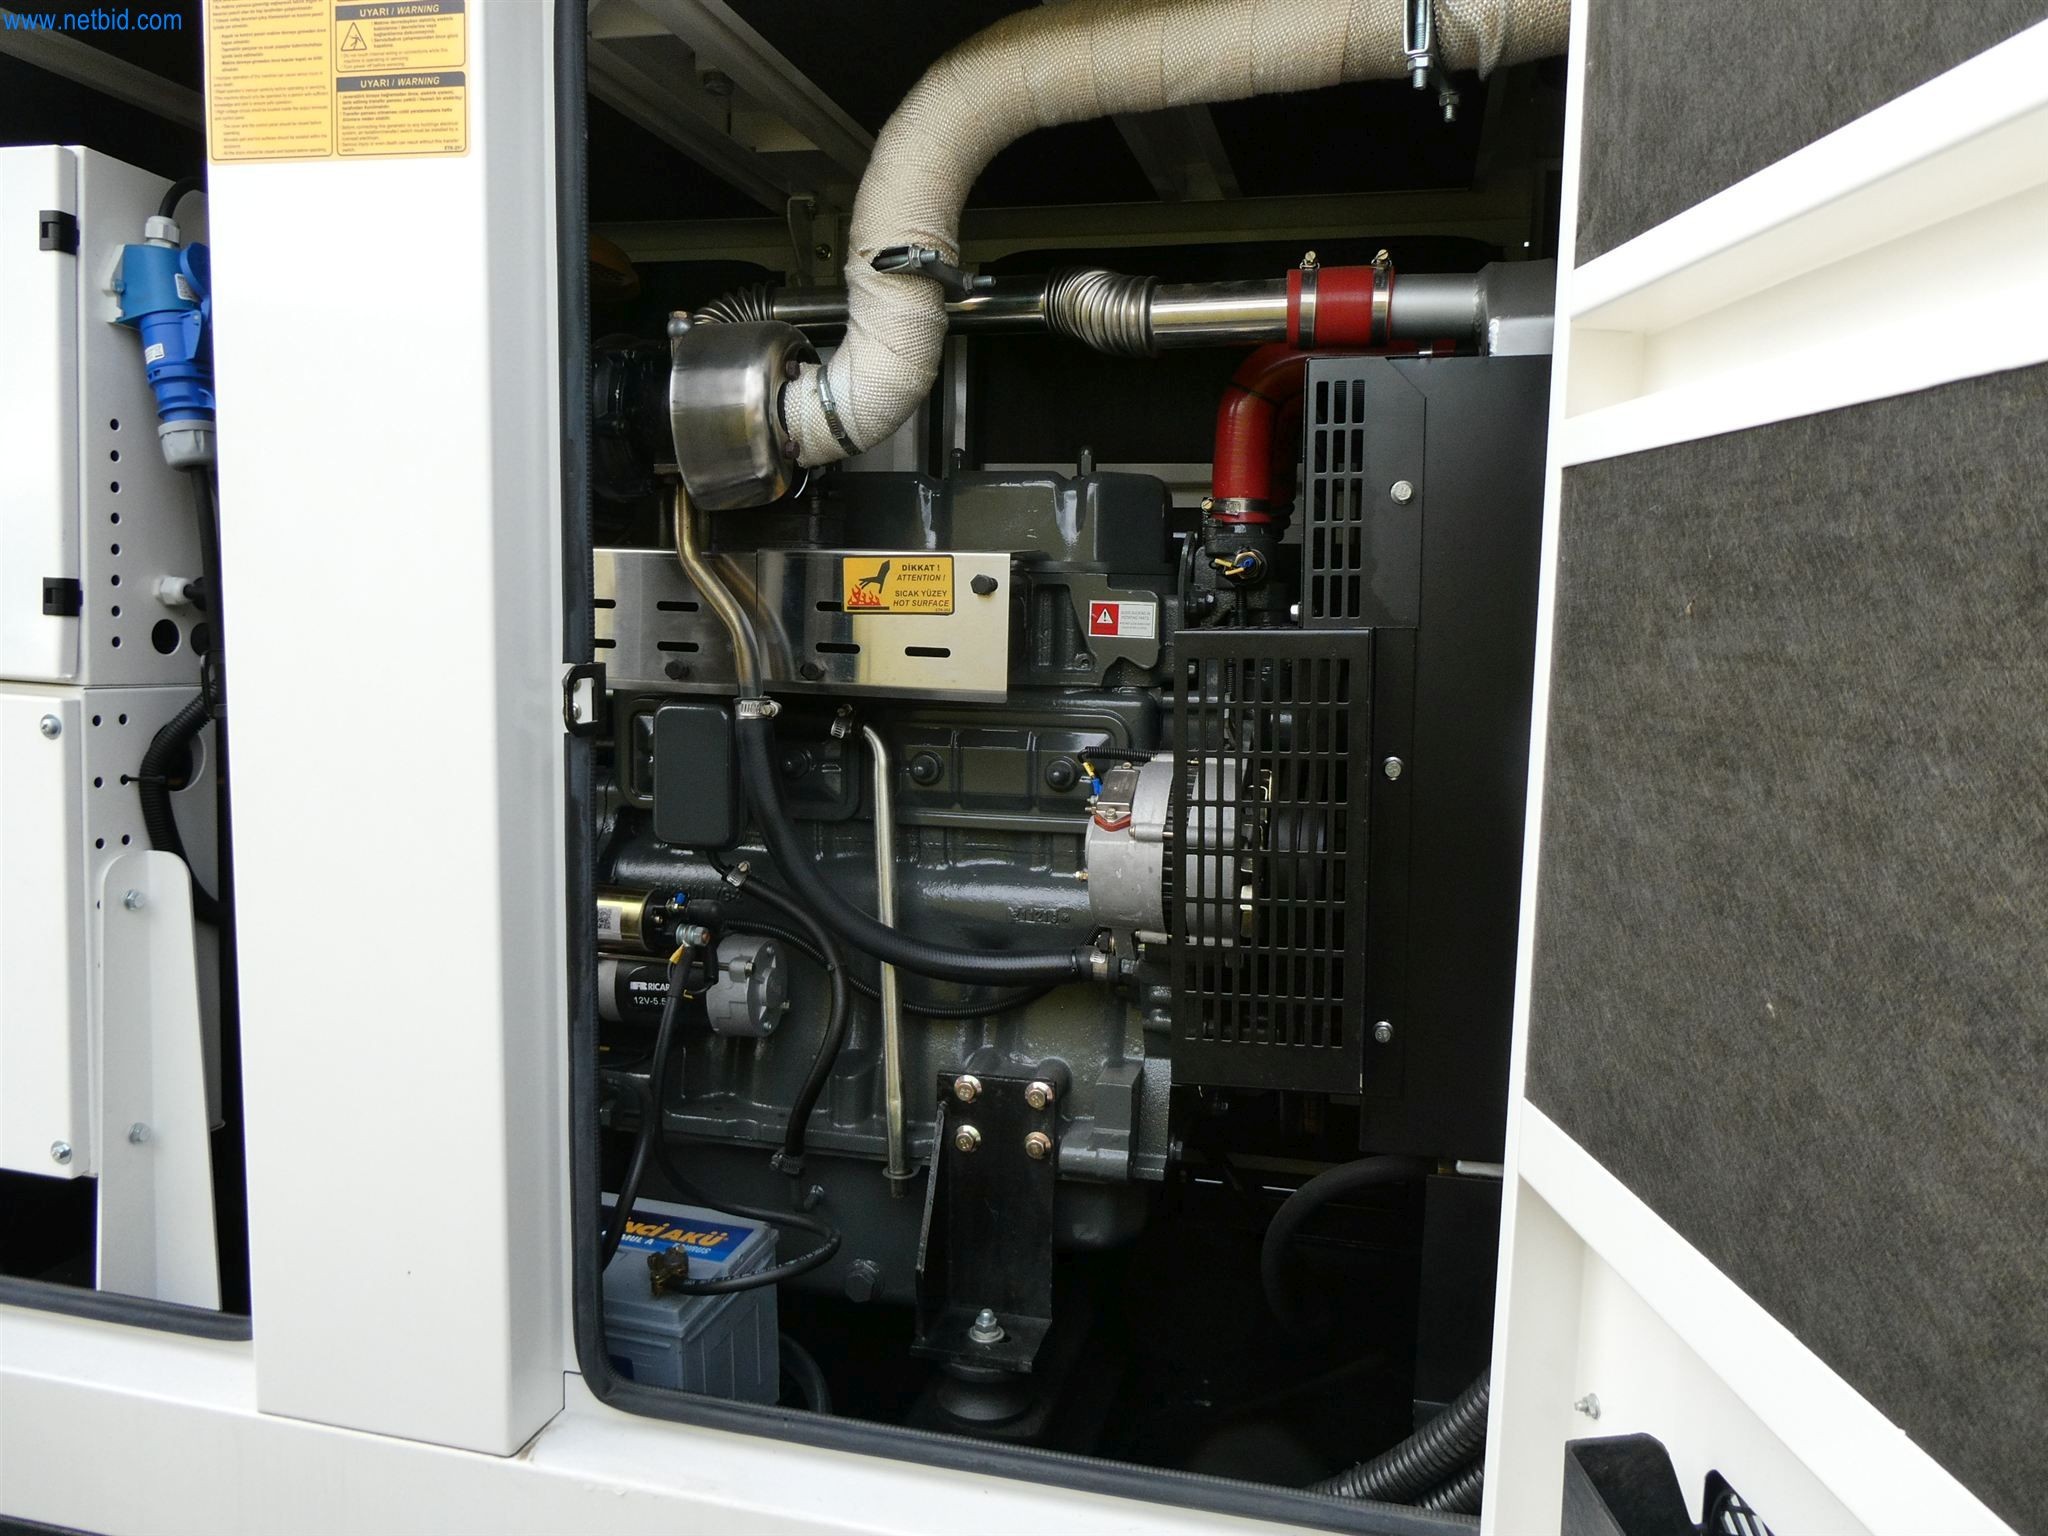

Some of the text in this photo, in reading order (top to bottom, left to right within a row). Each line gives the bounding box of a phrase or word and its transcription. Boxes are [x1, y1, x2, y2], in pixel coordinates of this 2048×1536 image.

[360, 8, 389, 17] UYARI
[397, 4, 440, 14] WARNING
[360, 79, 390, 88] UYARI
[397, 76, 440, 86] WARNING
[901, 563, 935, 571] DİKKAT
[896, 574, 942, 582] ATTENTION
[921, 588, 947, 597] YÜZEY
[893, 599, 909, 607] HOT
[659, 1228, 728, 1247] AKÜ
